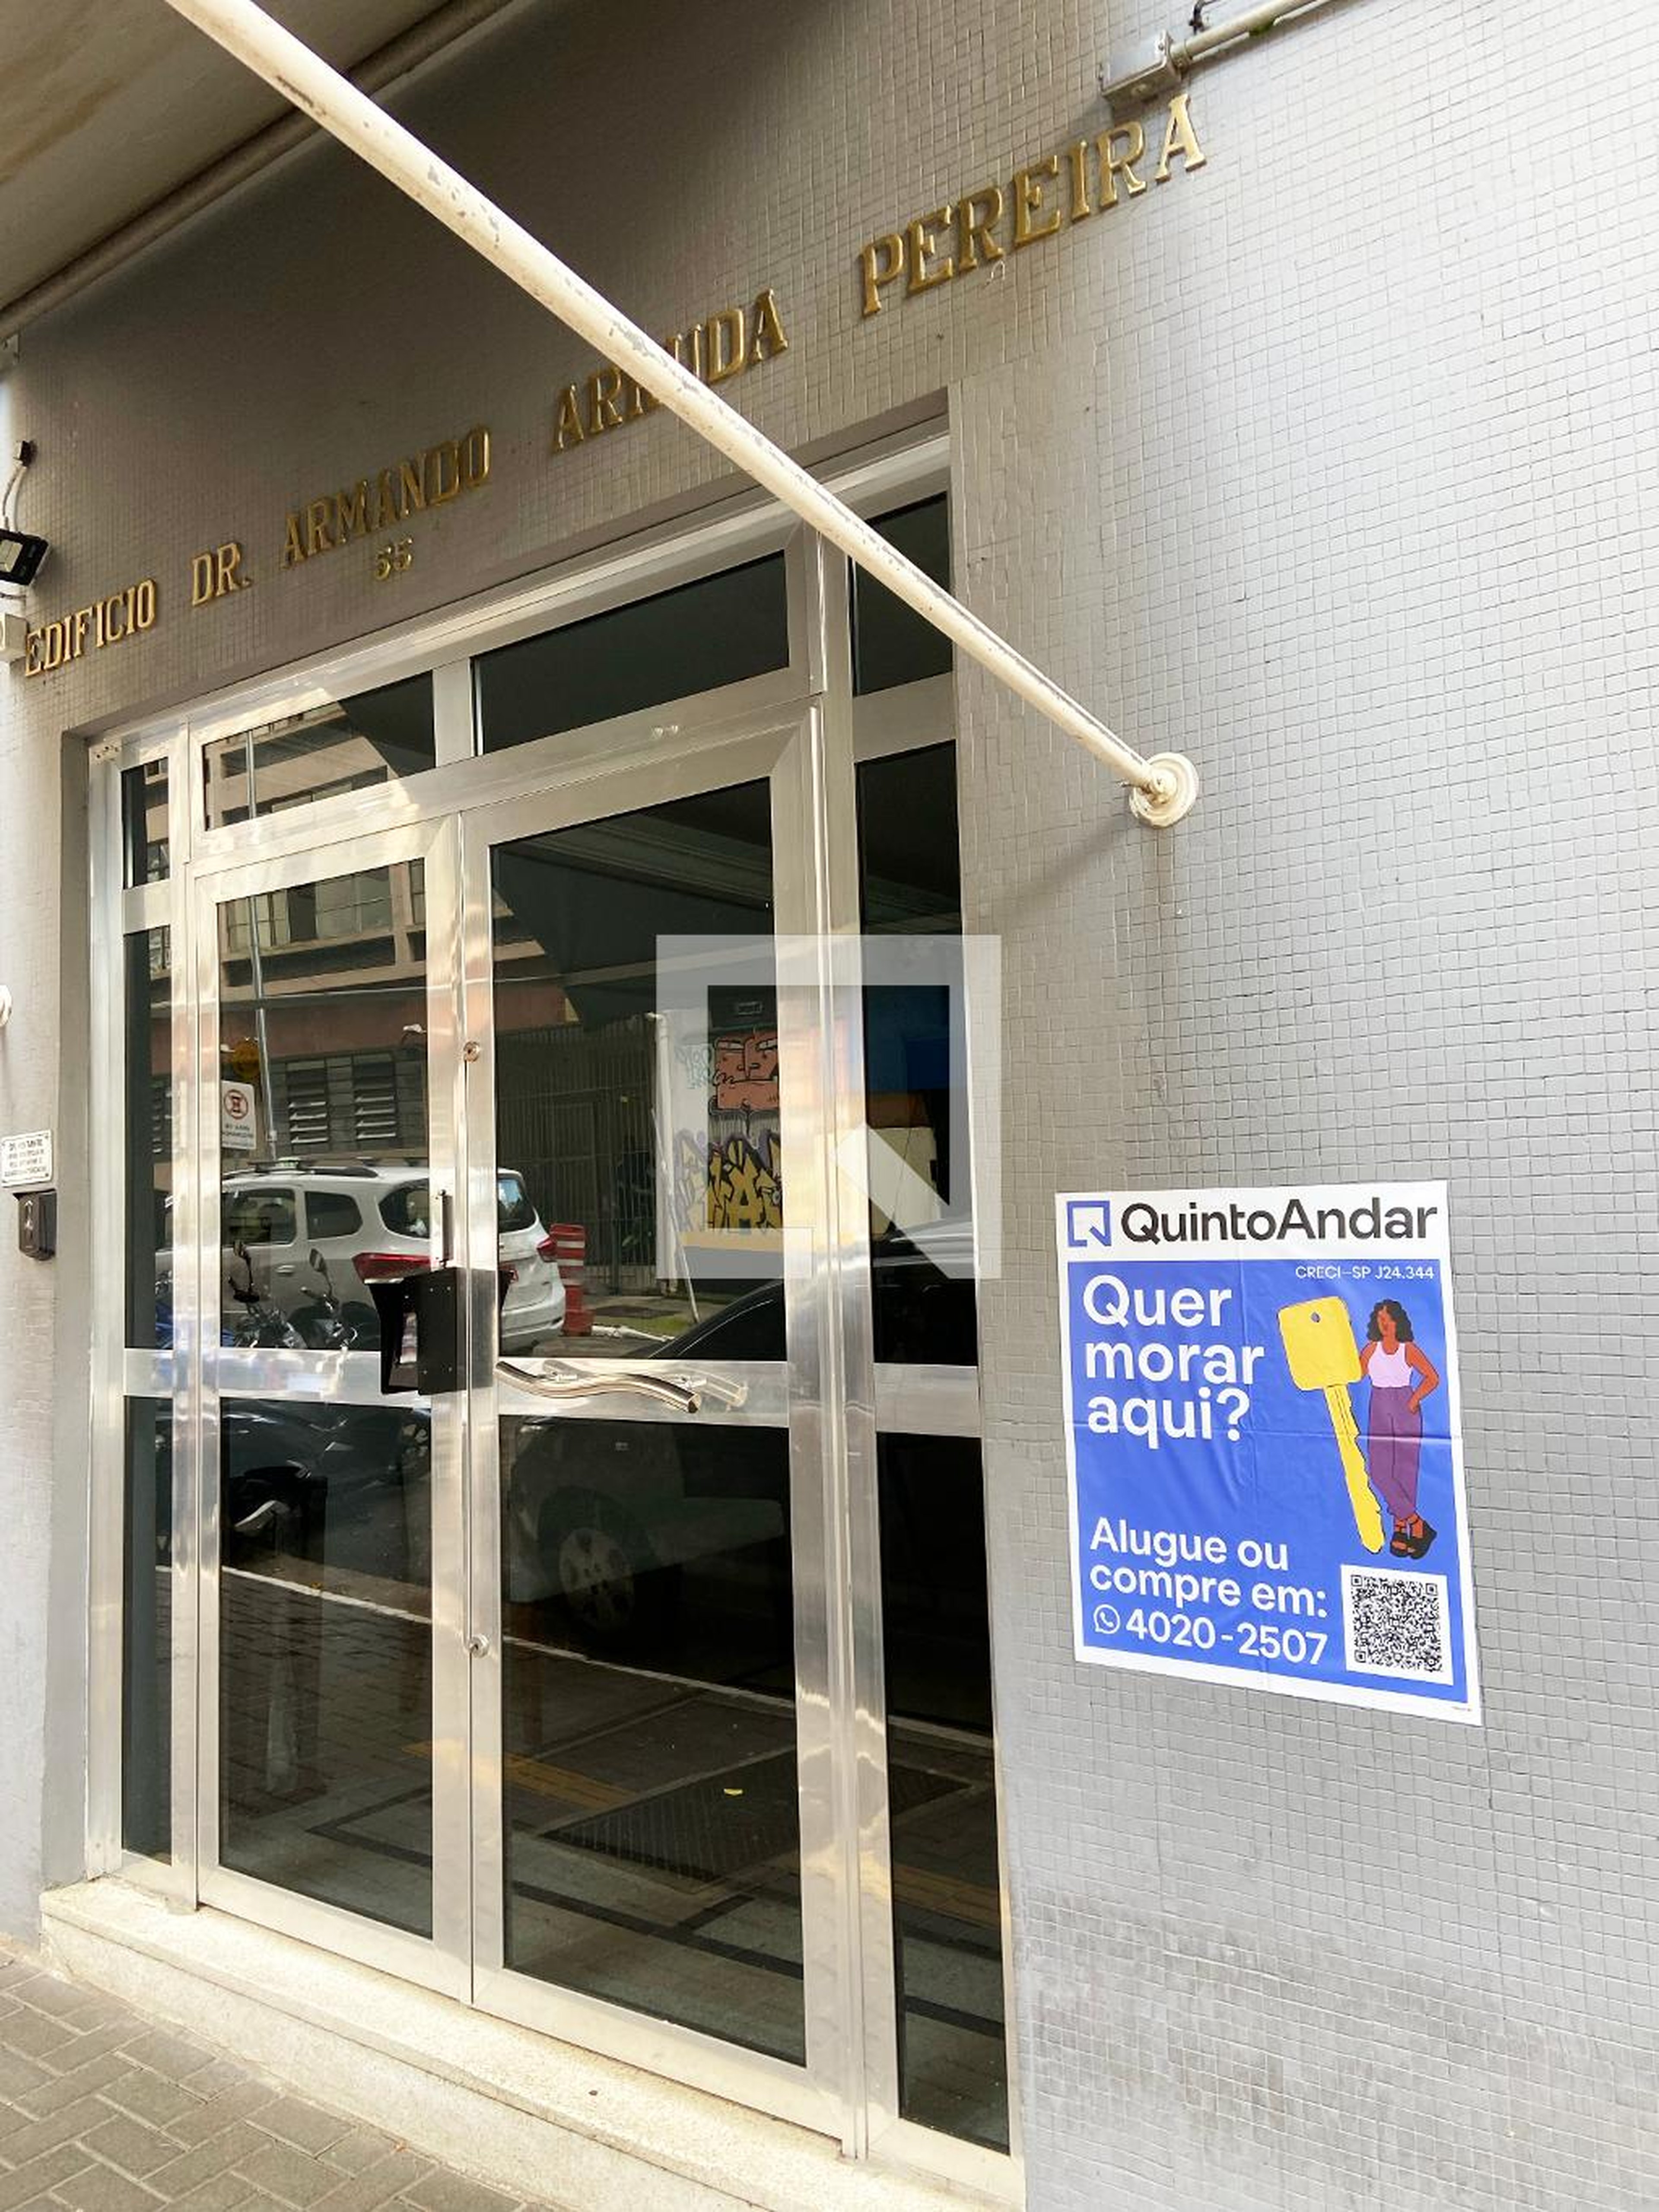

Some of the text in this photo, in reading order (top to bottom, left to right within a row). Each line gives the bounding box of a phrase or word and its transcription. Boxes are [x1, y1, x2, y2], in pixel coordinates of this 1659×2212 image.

[25, 579, 156, 677] EDIFICIO
[192, 543, 251, 606] DR.
[280, 425, 493, 571] ARMANDO
[859, 93, 1207, 316] PEREIRA
[1121, 1197, 1437, 1244] QuintoAndar
[1375, 1265, 1434, 1279] J24.344
[1083, 1274, 1232, 1328] Quer
[1086, 1341, 1265, 1385] morar
[1087, 1388, 1250, 1449] aqui?
[1090, 1516, 1288, 1571] Alugue ou
[1090, 1564, 1327, 1618] compre em:
